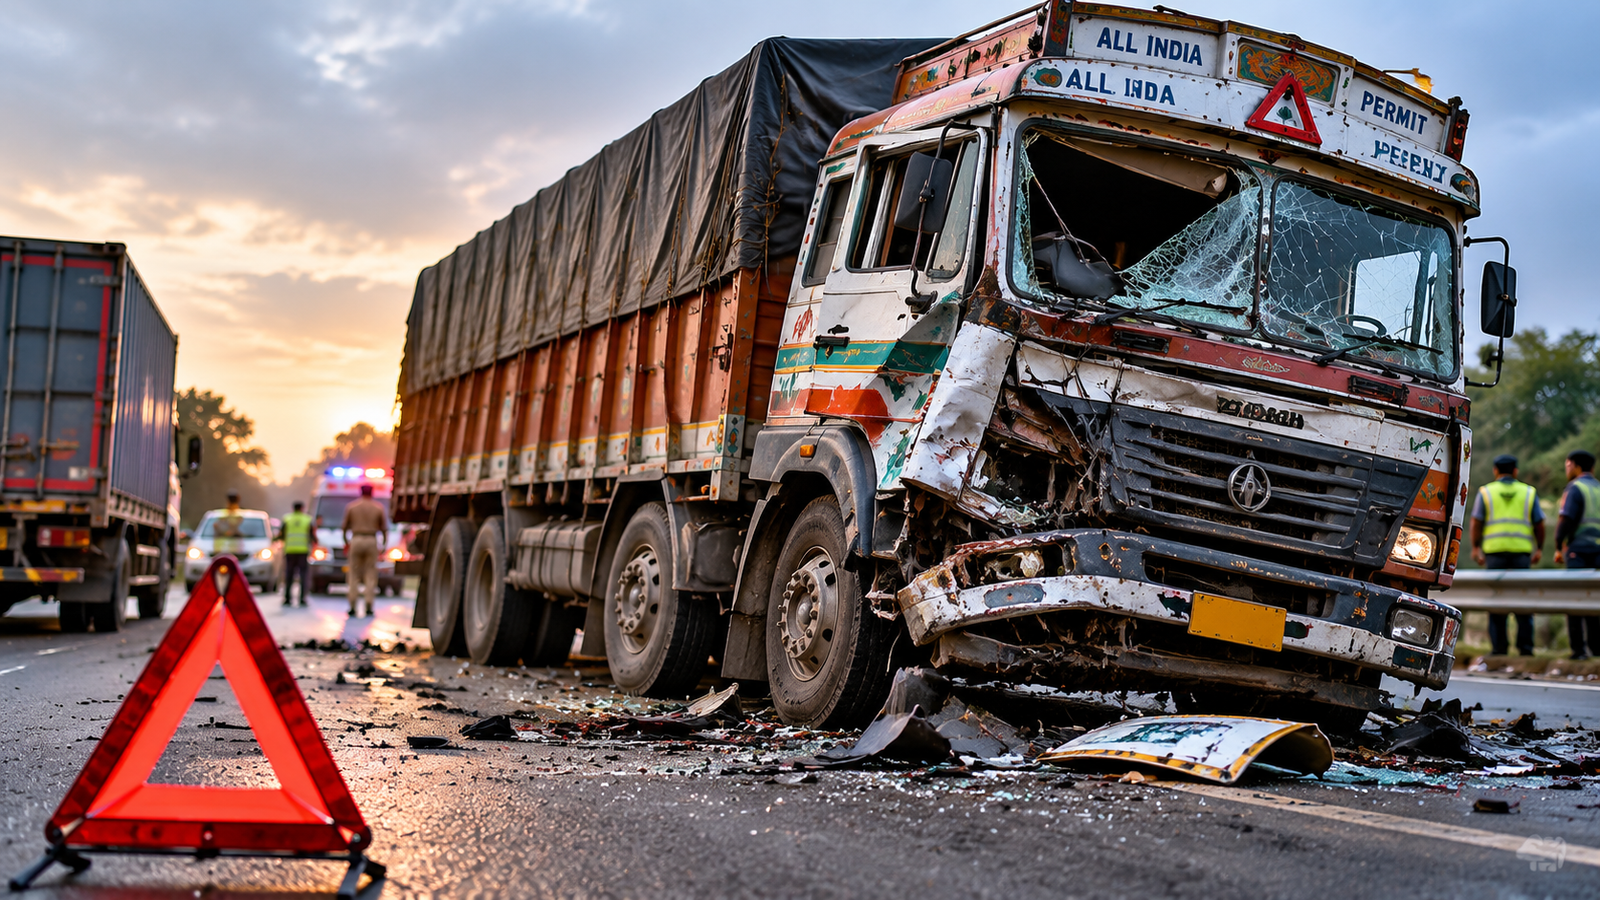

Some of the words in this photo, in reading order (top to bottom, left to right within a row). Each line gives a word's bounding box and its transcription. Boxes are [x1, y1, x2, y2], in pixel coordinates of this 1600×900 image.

[1096, 26, 1138, 54] ALL
[1146, 34, 1203, 66] INDIA
[1360, 90, 1428, 135] PERMIT
